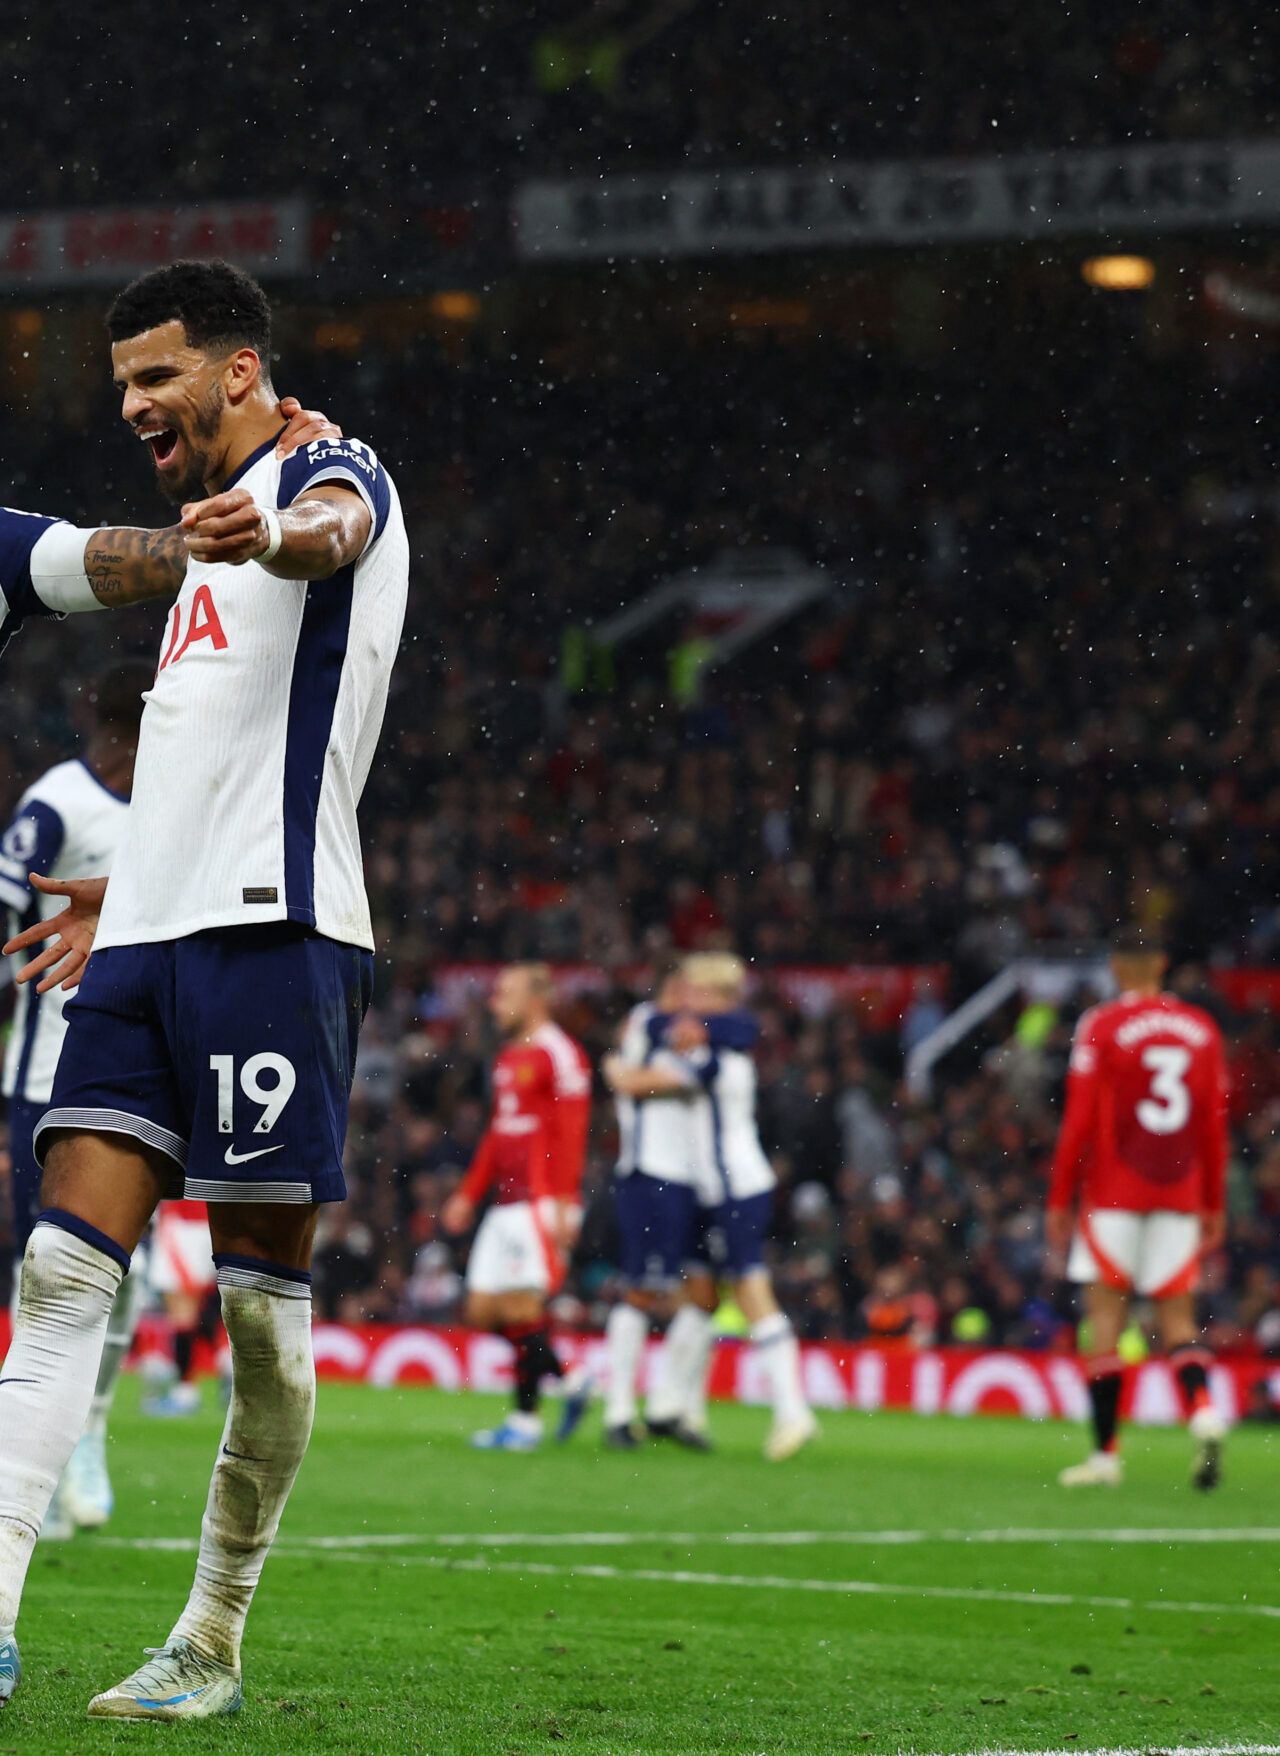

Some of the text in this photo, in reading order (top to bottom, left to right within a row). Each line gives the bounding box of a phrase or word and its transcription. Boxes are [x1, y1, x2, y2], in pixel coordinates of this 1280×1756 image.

[157, 585, 228, 672] IA
[210, 1052, 296, 1133] 19
[1136, 1045, 1191, 1134] 3
